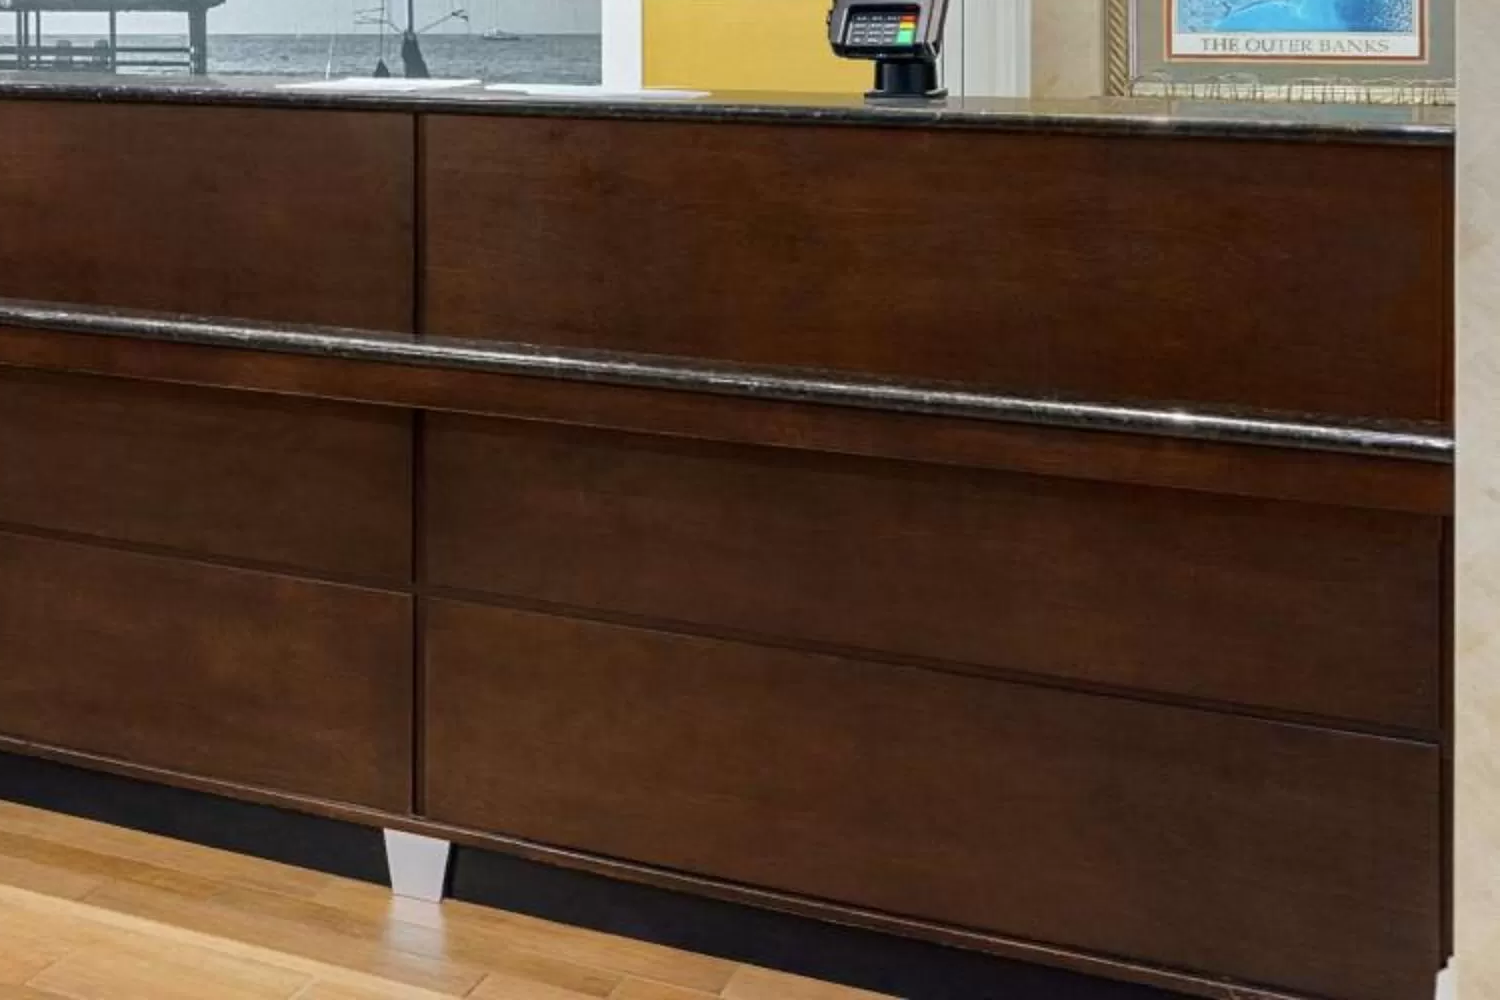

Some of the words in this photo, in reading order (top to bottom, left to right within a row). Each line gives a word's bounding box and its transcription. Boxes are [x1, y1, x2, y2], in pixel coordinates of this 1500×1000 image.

[1200, 37, 1241, 52] THE
[1245, 38, 1313, 53] OUTER
[1320, 38, 1390, 53] BANKS
